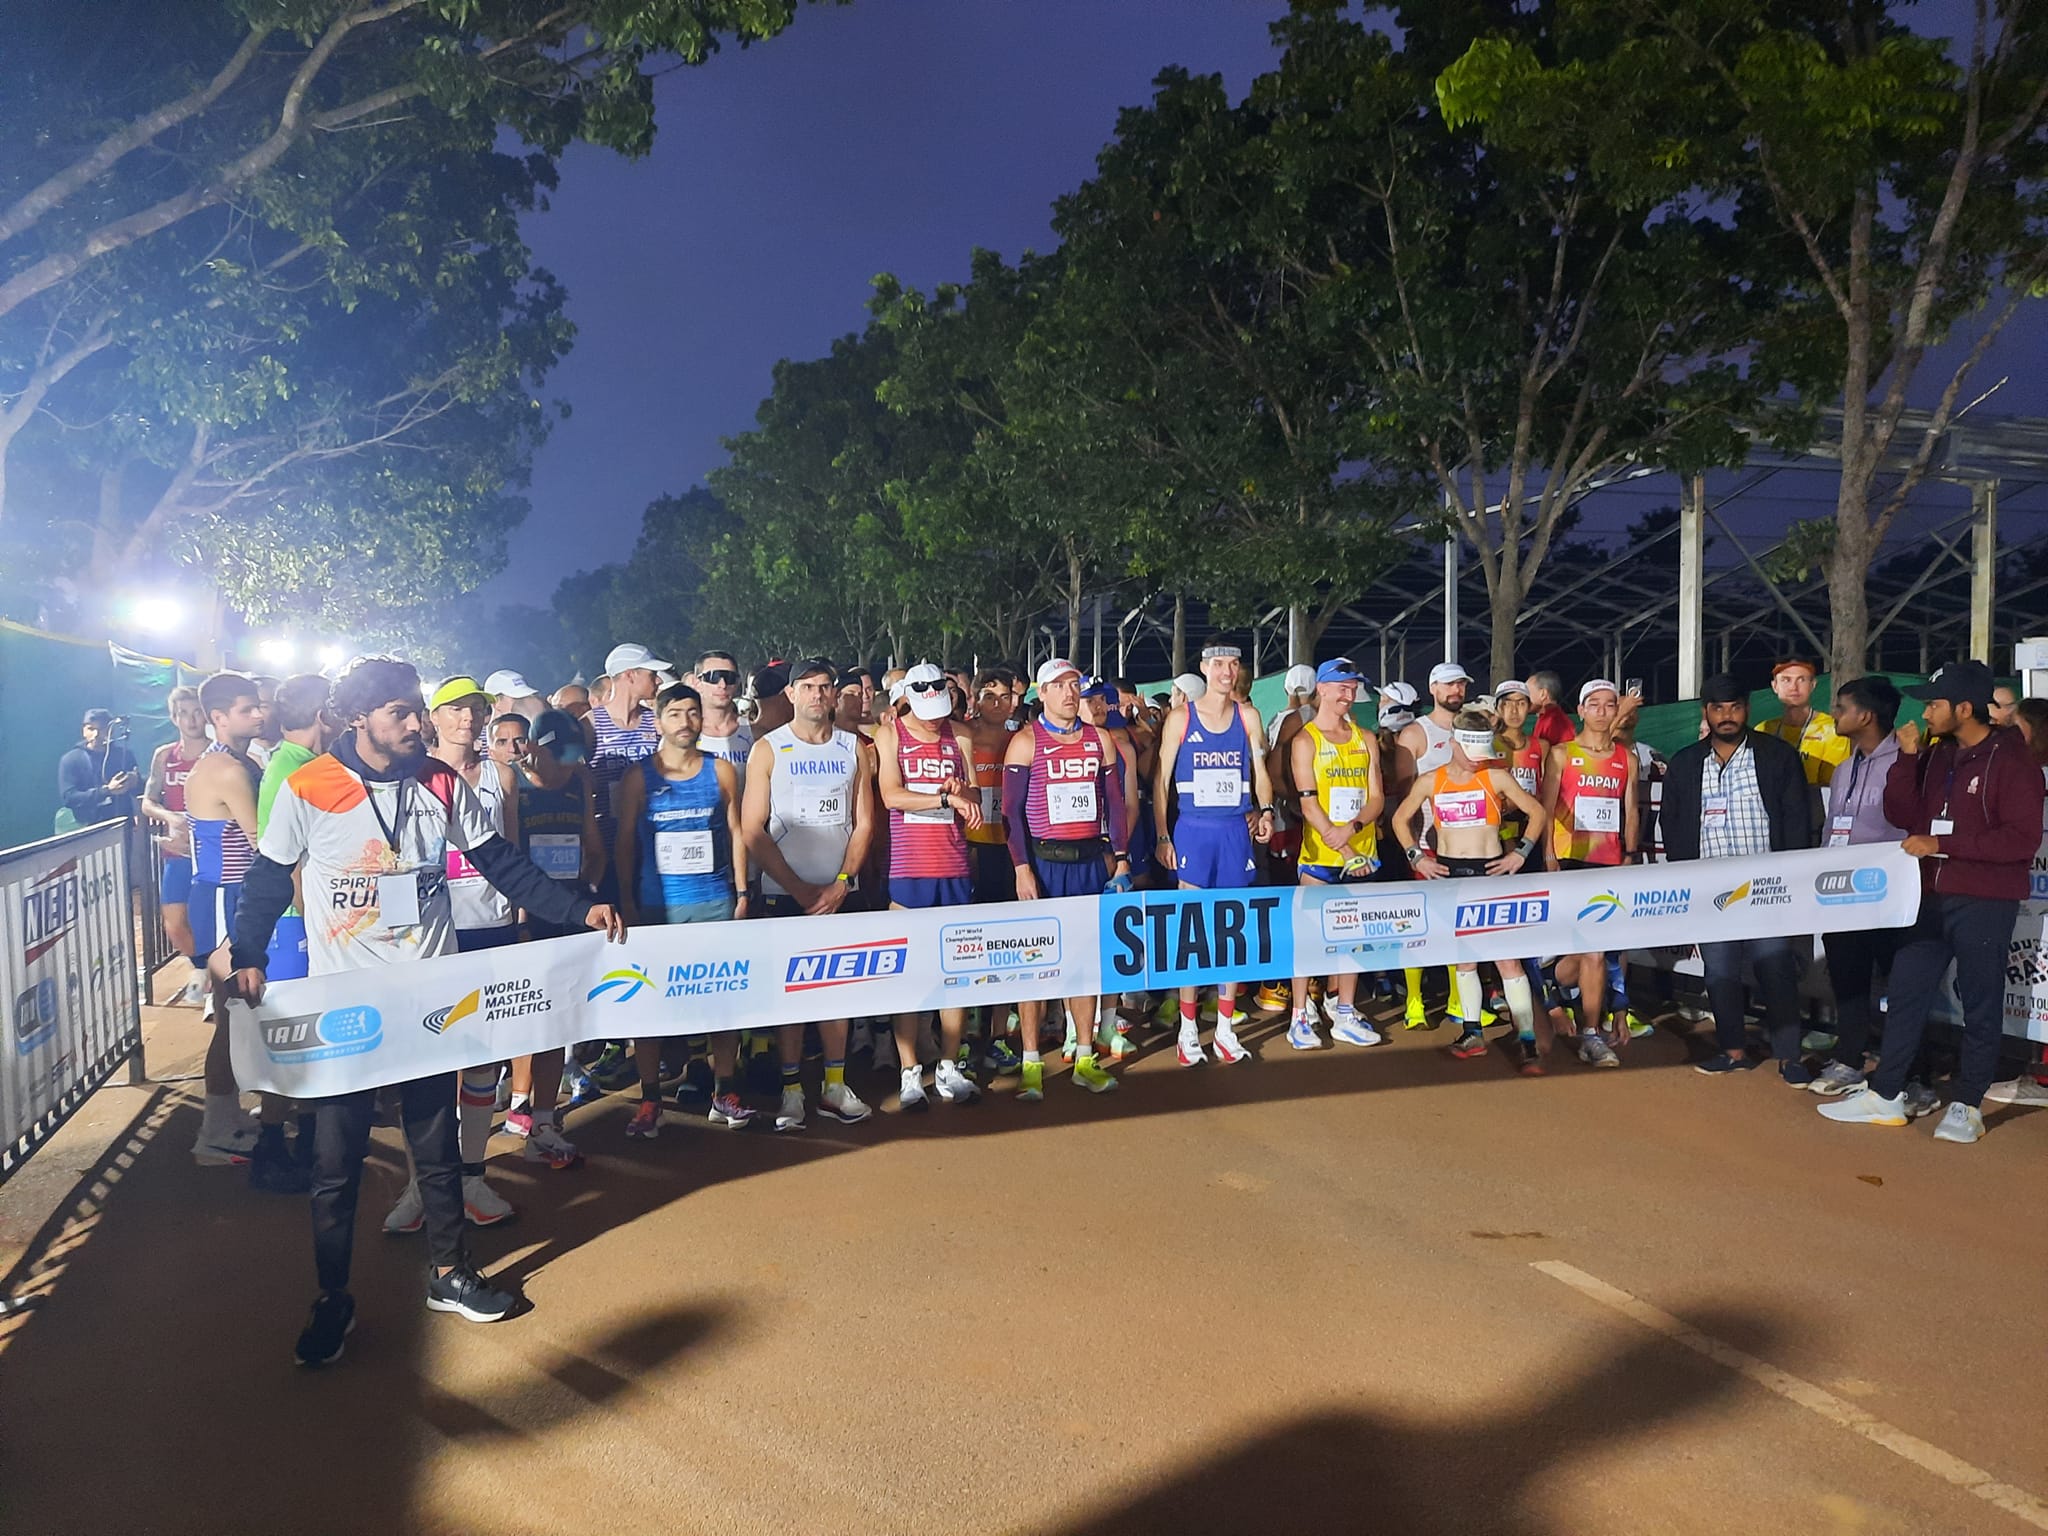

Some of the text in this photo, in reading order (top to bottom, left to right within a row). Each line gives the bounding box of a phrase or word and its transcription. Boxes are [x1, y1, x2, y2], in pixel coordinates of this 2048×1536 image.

[605, 746, 655, 758] GREAT
[1194, 751, 1241, 767] FRANCE
[790, 760, 847, 775] UKRAINE
[903, 758, 955, 779] USA
[1047, 757, 1099, 779] USA
[1326, 767, 1366, 778] SWEDEN
[1216, 781, 1234, 793] 239
[1578, 774, 1620, 790] JAPAN
[819, 798, 839, 812] 290
[1071, 795, 1089, 808] 299
[1458, 803, 1477, 816] 148
[1596, 809, 1612, 820] 257
[1752, 876, 1782, 888] WORLD
[1633, 888, 1691, 906] INDIAN
[1751, 885, 1787, 897] MASTERS
[1751, 894, 1792, 907] ATHLETICS
[1361, 908, 1421, 922] BENGALURU
[1459, 902, 1544, 929] NEB
[1631, 903, 1690, 919] ATHLETICS
[1363, 921, 1394, 936] 100K
[957, 936, 1055, 954] 2024 BENGALURU
[1113, 897, 1280, 977] START
[988, 950, 1024, 966] 100K
[668, 959, 750, 982] INDIAN
[790, 950, 900, 983] NEB
[484, 978, 531, 997] WORLD
[665, 978, 749, 997] ATHLETICS
[485, 988, 543, 1010] MASTERS
[485, 999, 552, 1022] ATHLETICS
[267, 1022, 308, 1045] IAU
